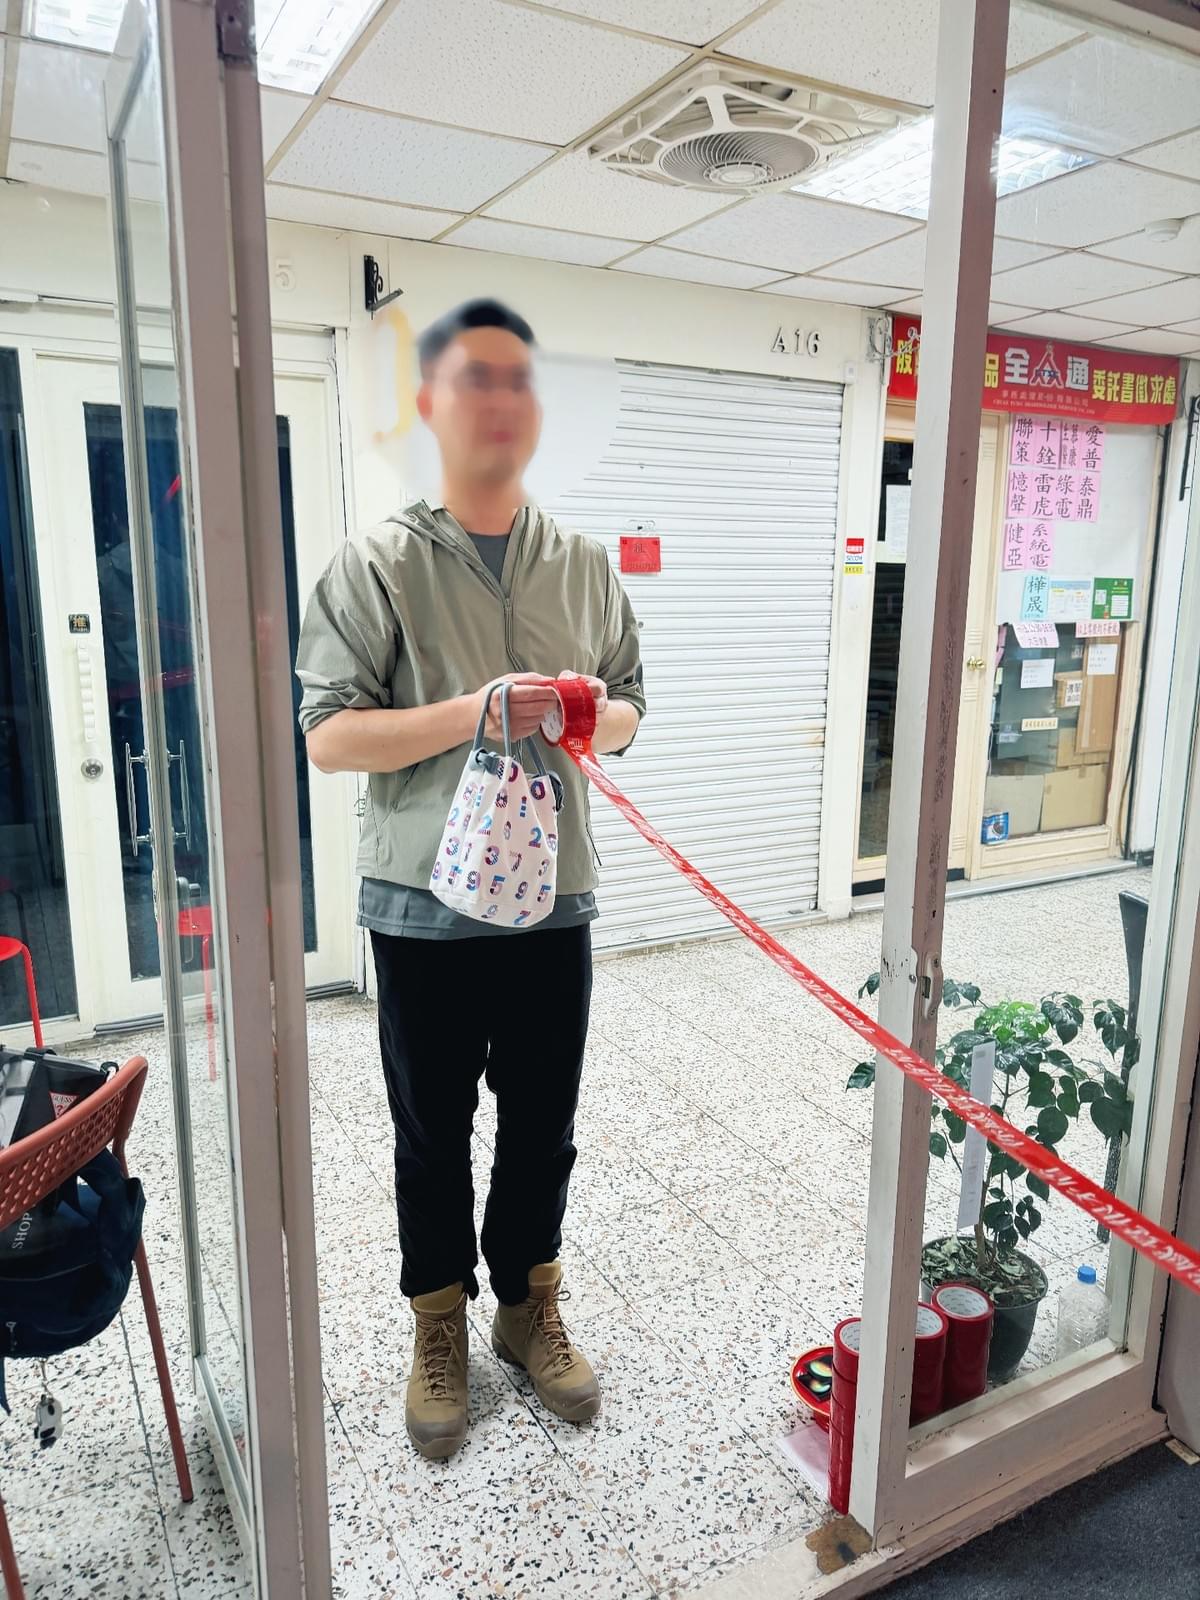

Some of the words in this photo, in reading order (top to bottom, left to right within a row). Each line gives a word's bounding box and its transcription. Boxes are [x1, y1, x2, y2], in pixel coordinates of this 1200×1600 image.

[770, 327, 821, 358] A16
[896, 339, 919, 375] 股
[1003, 347, 1030, 385] 全
[1065, 355, 1089, 391] 通
[1016, 418, 1033, 463] 聯策
[1036, 421, 1056, 465] 十銓
[1082, 425, 1103, 469] 愛普
[1011, 472, 1028, 513] 憶聲
[1032, 473, 1055, 517] 雷虎
[1056, 475, 1075, 518] 綠電
[1077, 476, 1096, 519] 泰鼎
[1007, 523, 1025, 567] 健亞
[1029, 523, 1051, 568] 系統電
[485, 845, 499, 865] 3
[528, 827, 542, 848] 2
[489, 875, 506, 896] 5
[515, 881, 528, 900] 9
[537, 884, 551, 903] 5
[12, 1212, 33, 1249] SHOP
